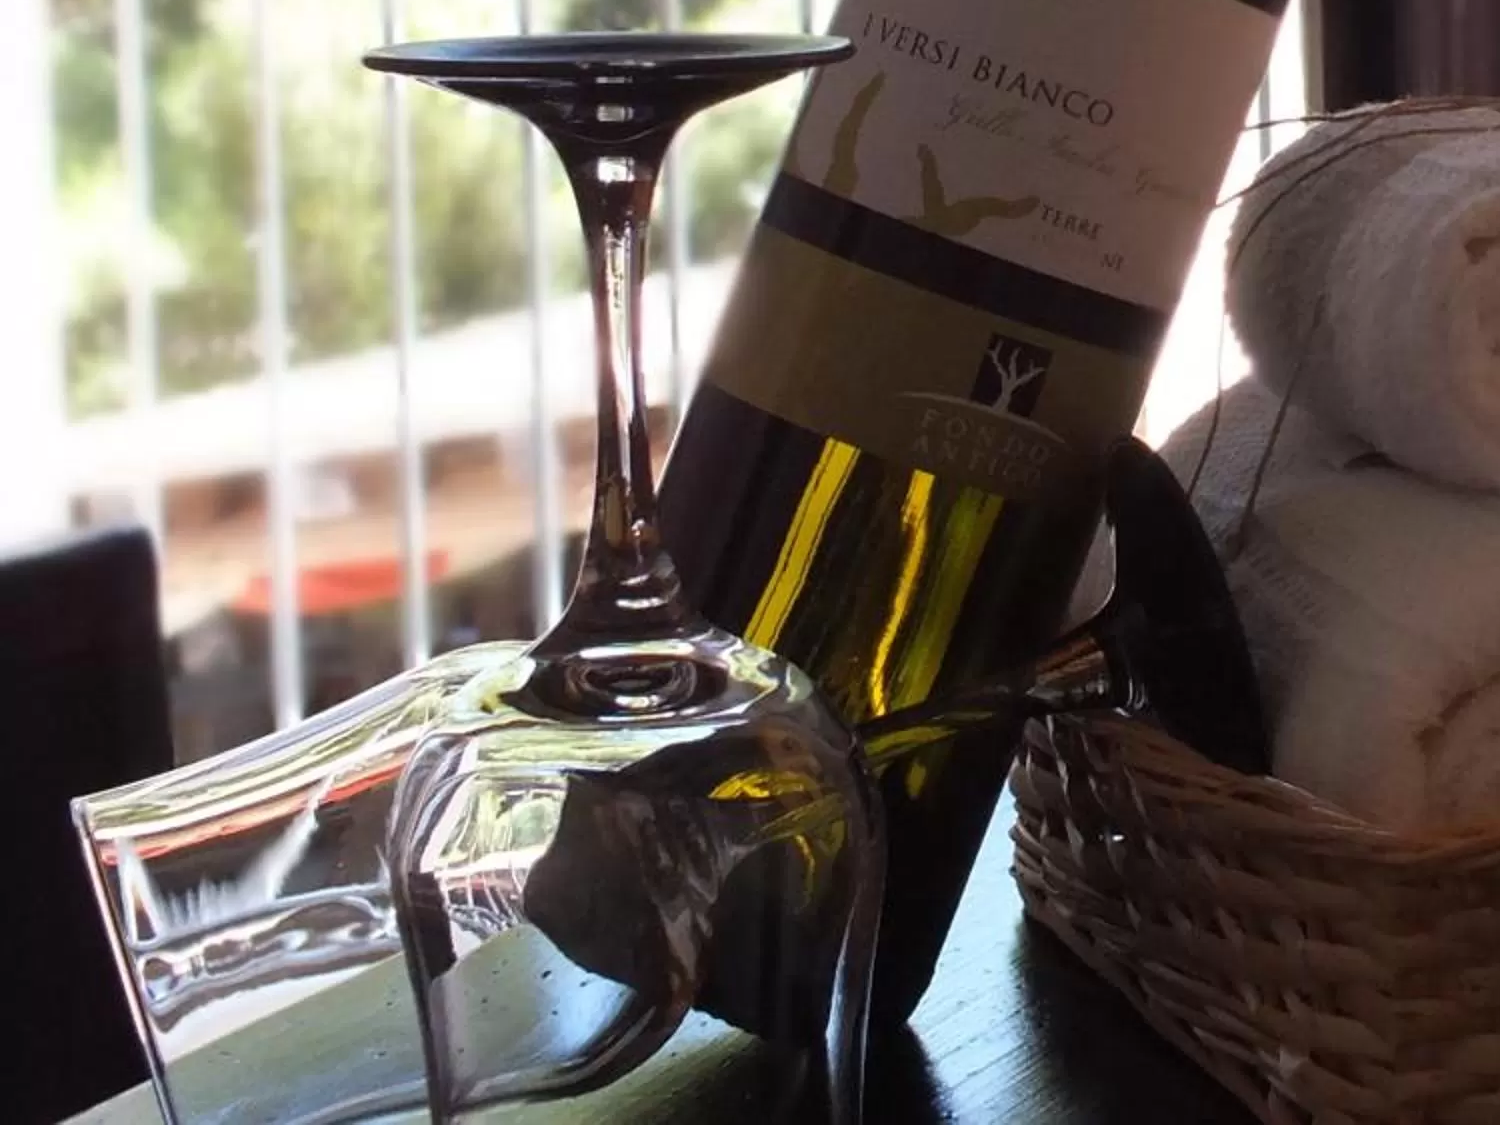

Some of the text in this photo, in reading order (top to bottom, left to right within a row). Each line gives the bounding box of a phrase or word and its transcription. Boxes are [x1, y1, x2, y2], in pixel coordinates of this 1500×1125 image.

[863, 11, 1115, 127] I VERSI BIANCO
[1041, 203, 1104, 240] TERRE
[921, 408, 1050, 465] FONDO
